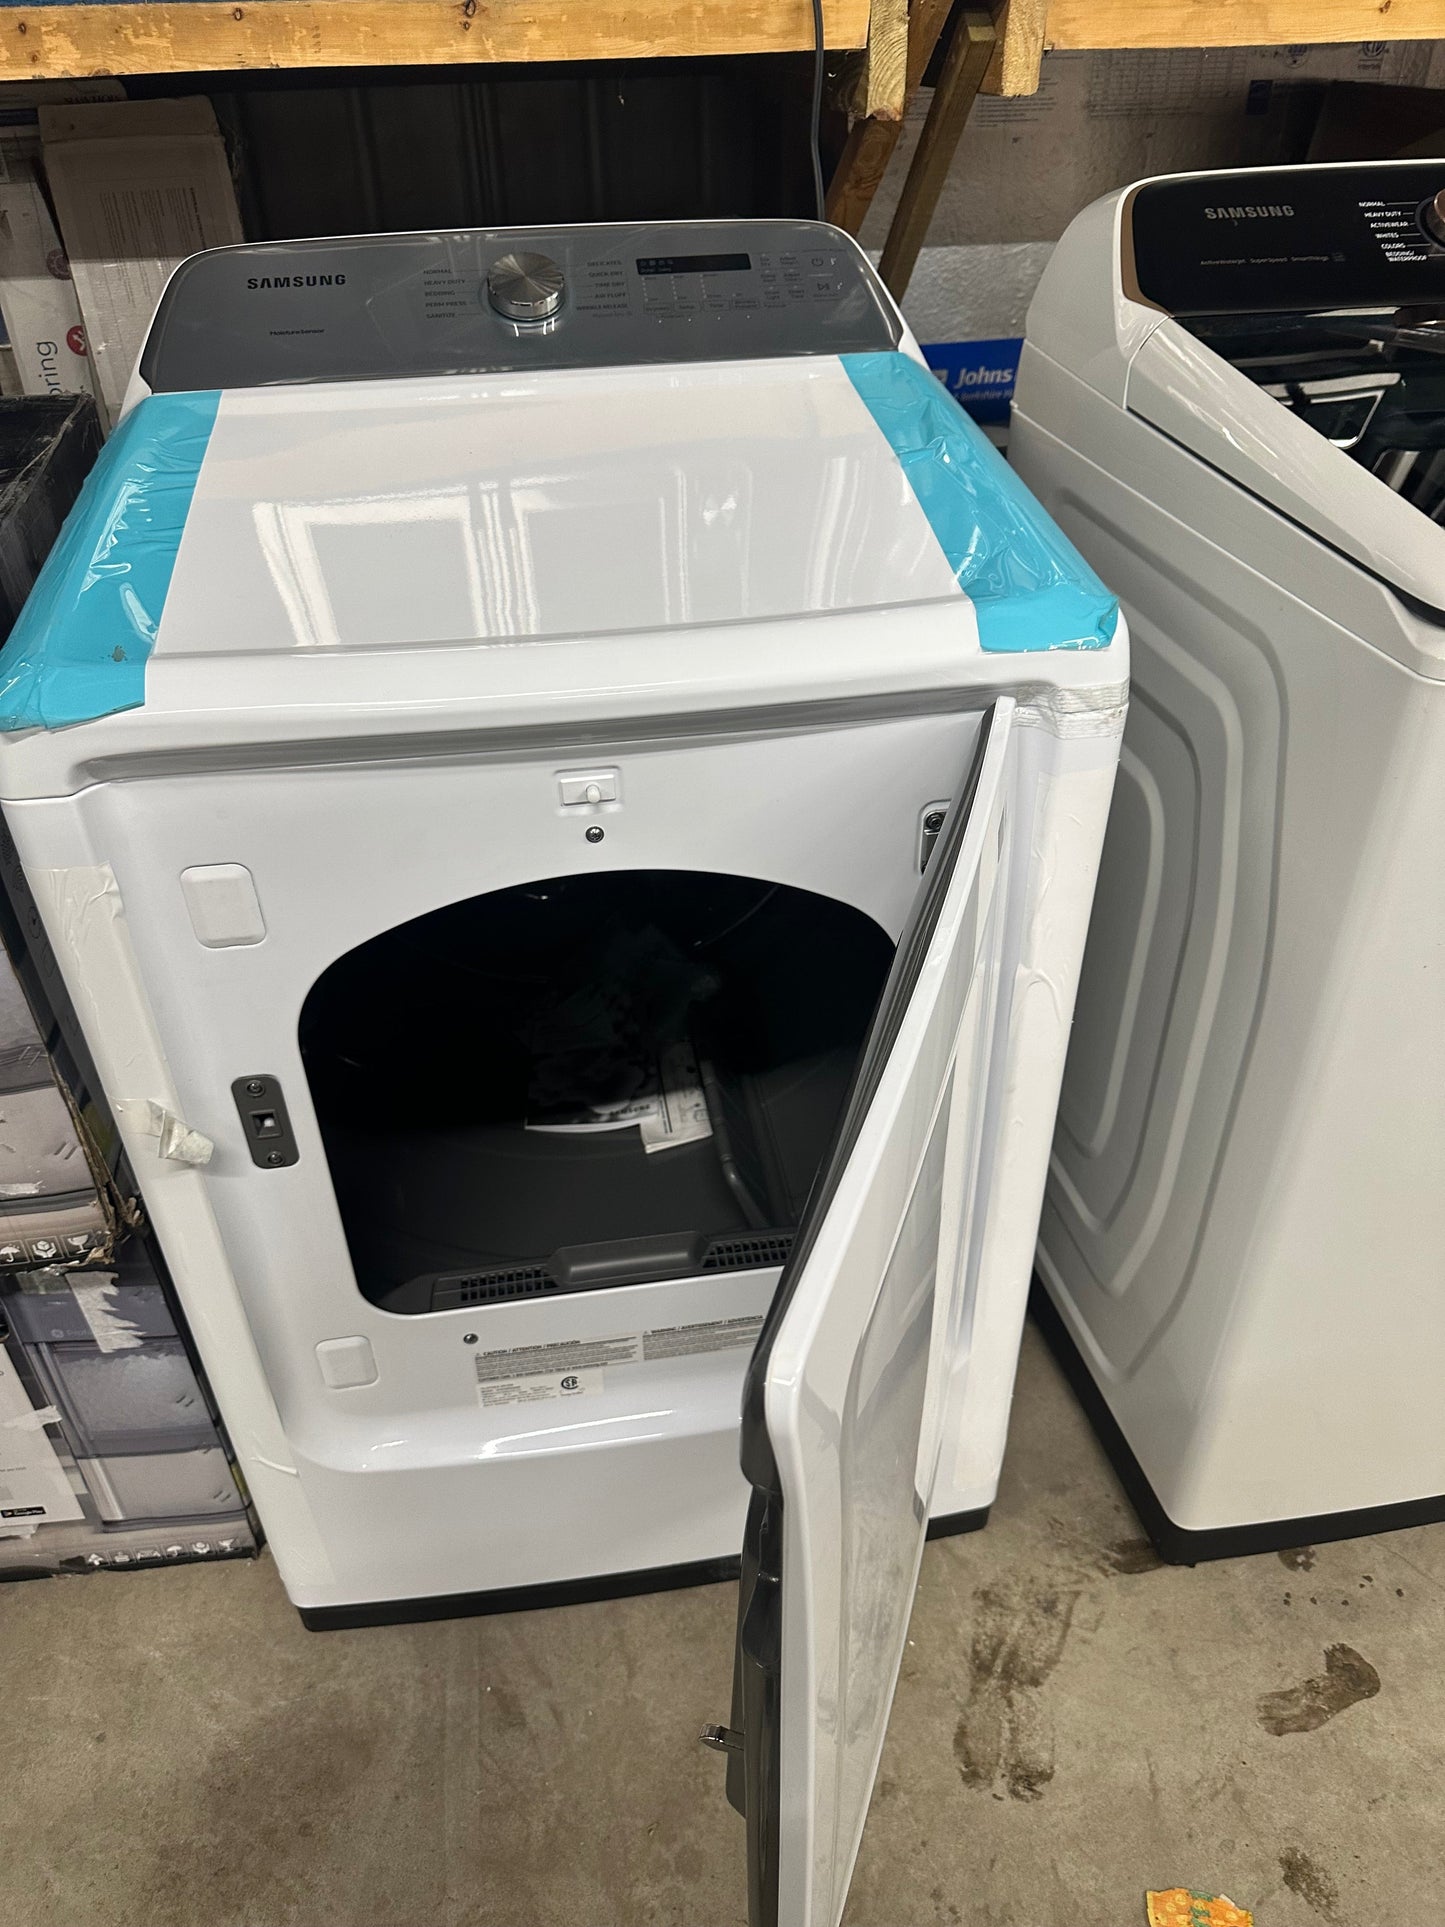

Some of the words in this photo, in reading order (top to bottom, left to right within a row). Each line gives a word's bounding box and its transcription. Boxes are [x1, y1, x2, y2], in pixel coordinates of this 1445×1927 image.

[1204, 205, 1295, 220] SAMSUNG
[247, 274, 346, 290] SAMSUNG
[483, 1348, 508, 1356] CAUTION
[512, 1344, 542, 1353] ATTENTION
